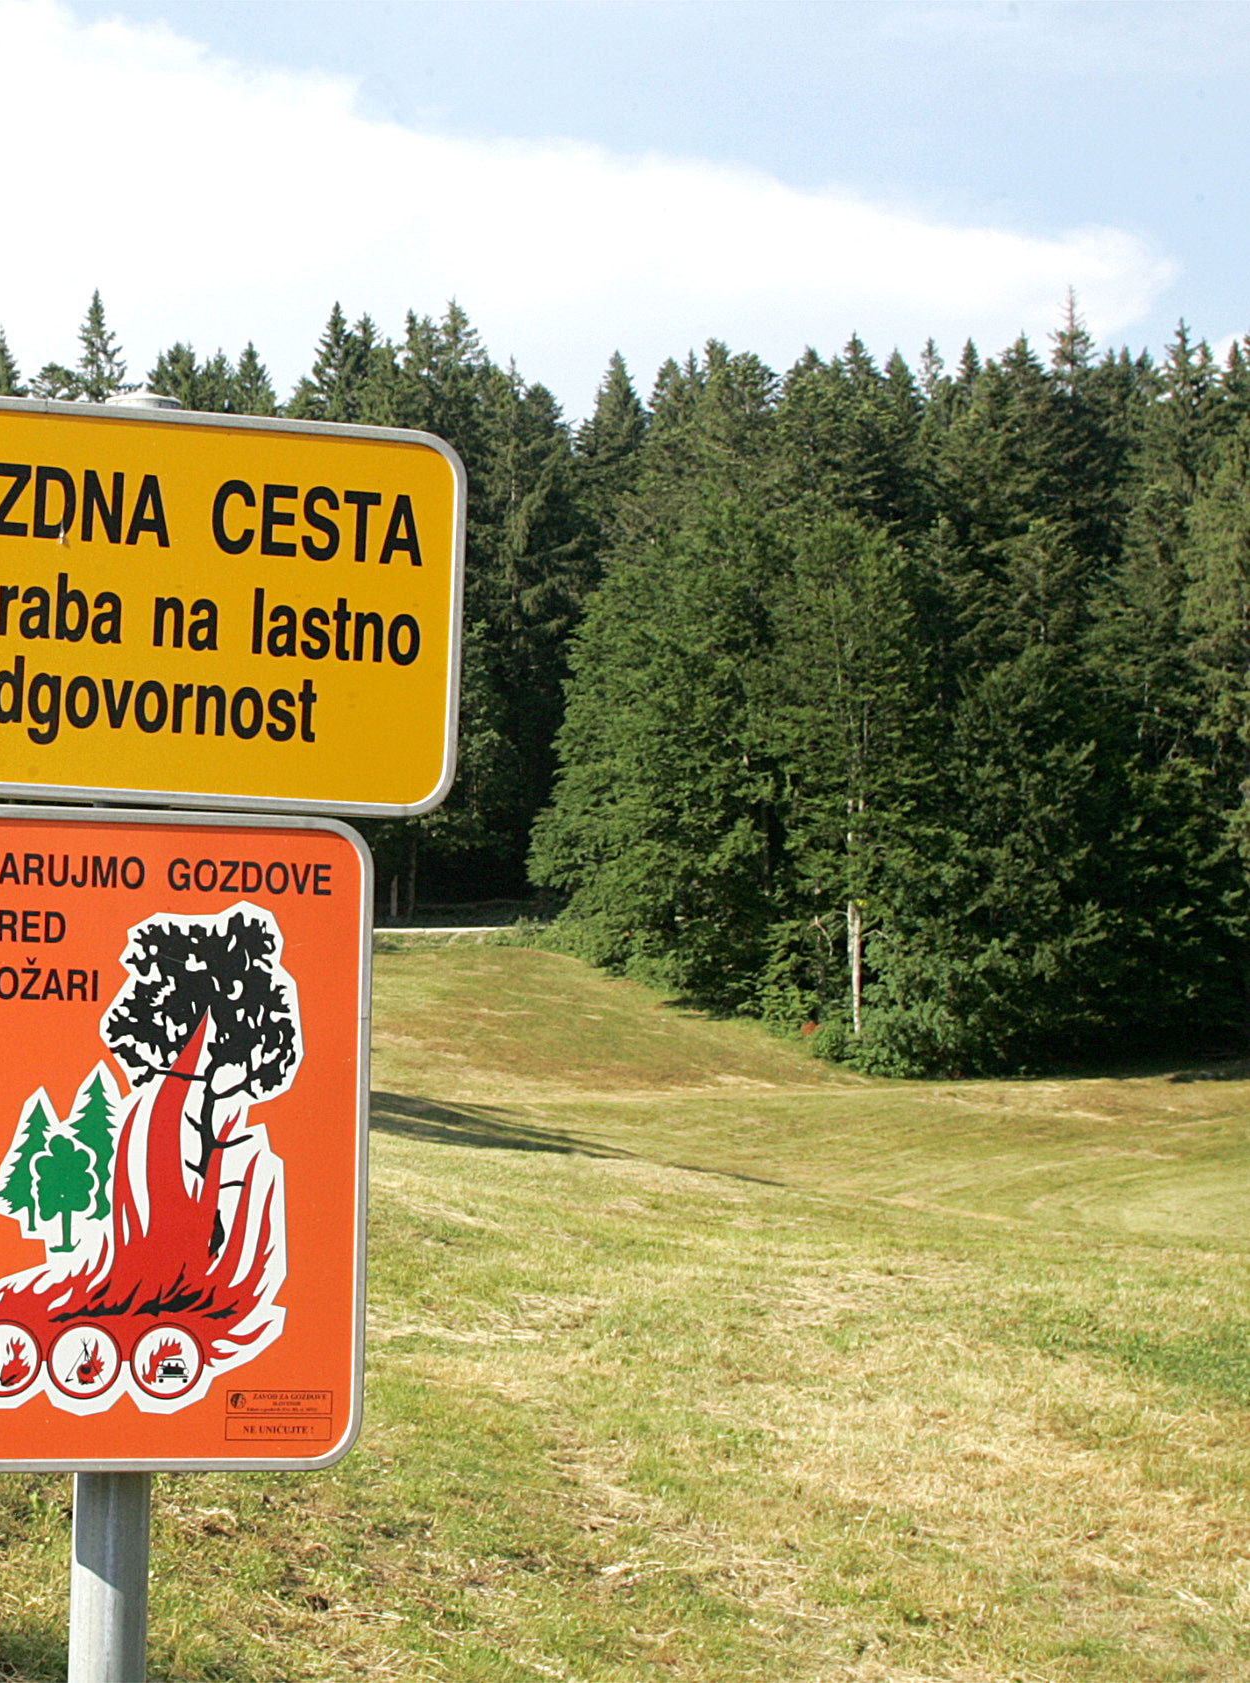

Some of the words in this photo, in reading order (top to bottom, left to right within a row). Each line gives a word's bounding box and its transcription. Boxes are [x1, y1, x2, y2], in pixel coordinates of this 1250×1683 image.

[212, 479, 423, 567] CESTA
[152, 596, 218, 651] na
[251, 587, 421, 666] lastno
[167, 858, 332, 896] GOZDOVE
[243, 1426, 256, 1434] NE
